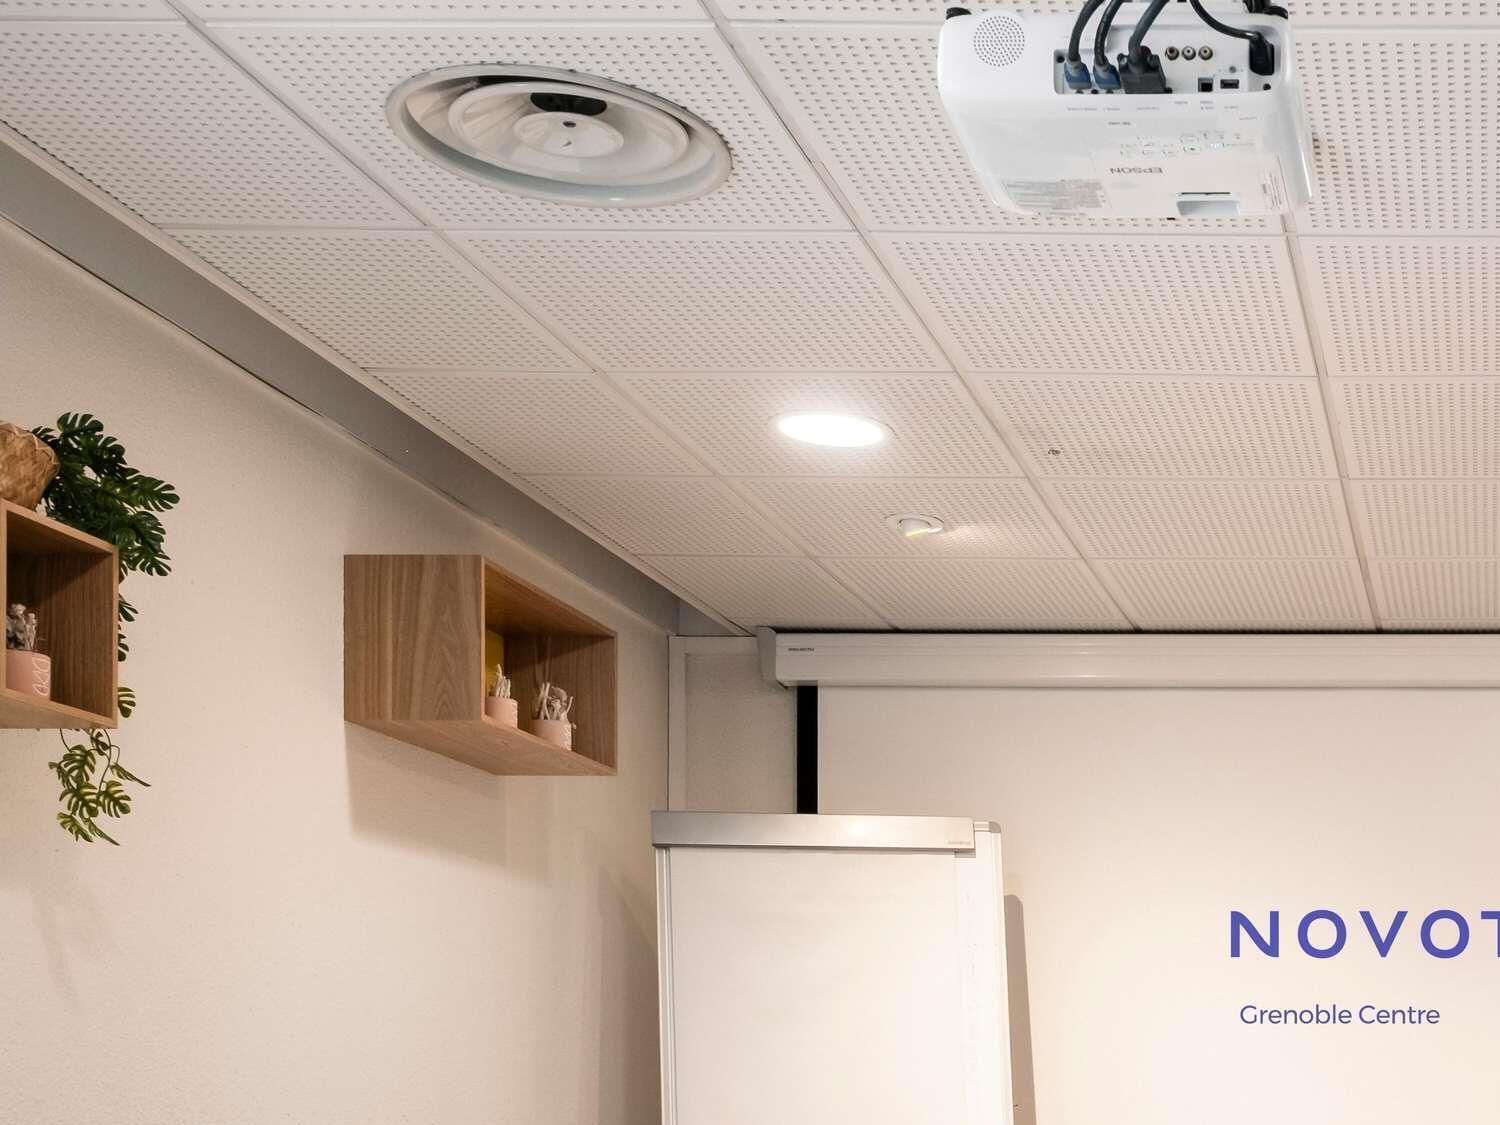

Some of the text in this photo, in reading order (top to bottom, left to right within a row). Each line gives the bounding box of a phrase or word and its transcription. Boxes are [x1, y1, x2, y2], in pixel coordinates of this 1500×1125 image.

[1109, 166, 1164, 175] EPSON
[1239, 1004, 1440, 1025] Grenoble Centre
